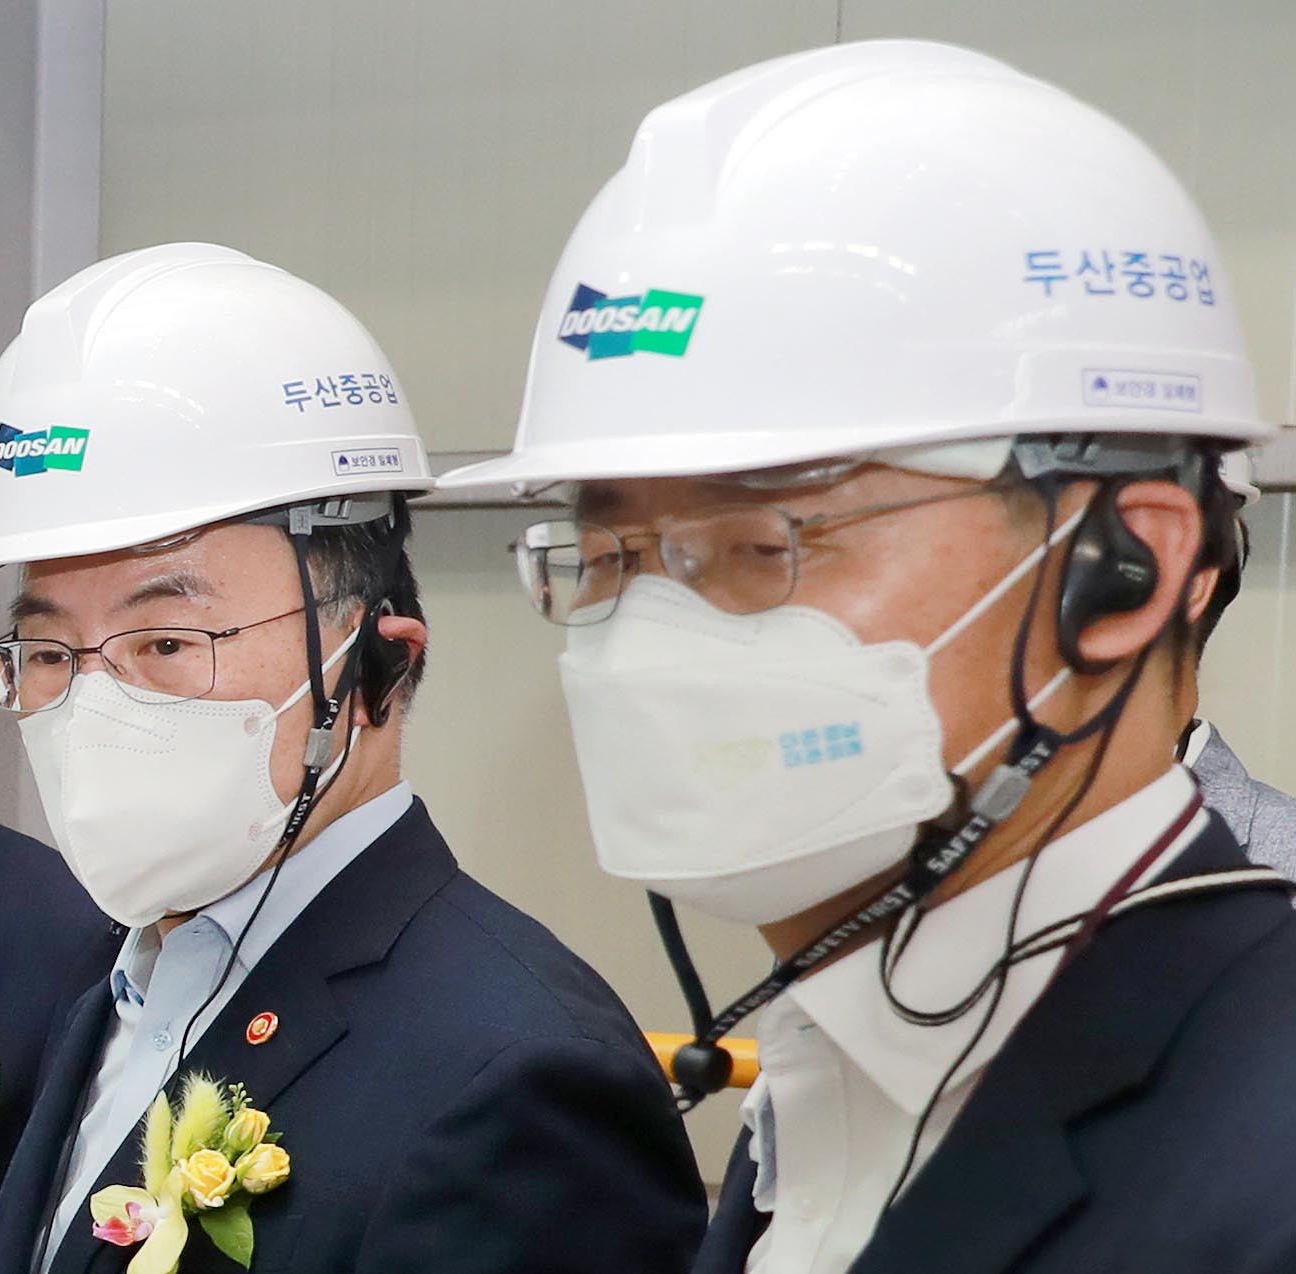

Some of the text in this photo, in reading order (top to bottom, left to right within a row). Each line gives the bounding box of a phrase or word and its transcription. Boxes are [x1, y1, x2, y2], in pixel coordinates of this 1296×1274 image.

[1024, 251, 1214, 306] 두산중공업
[559, 304, 697, 337] DOOSAN
[282, 373, 398, 412] 두산중공업
[926, 815, 990, 874] SAFET
